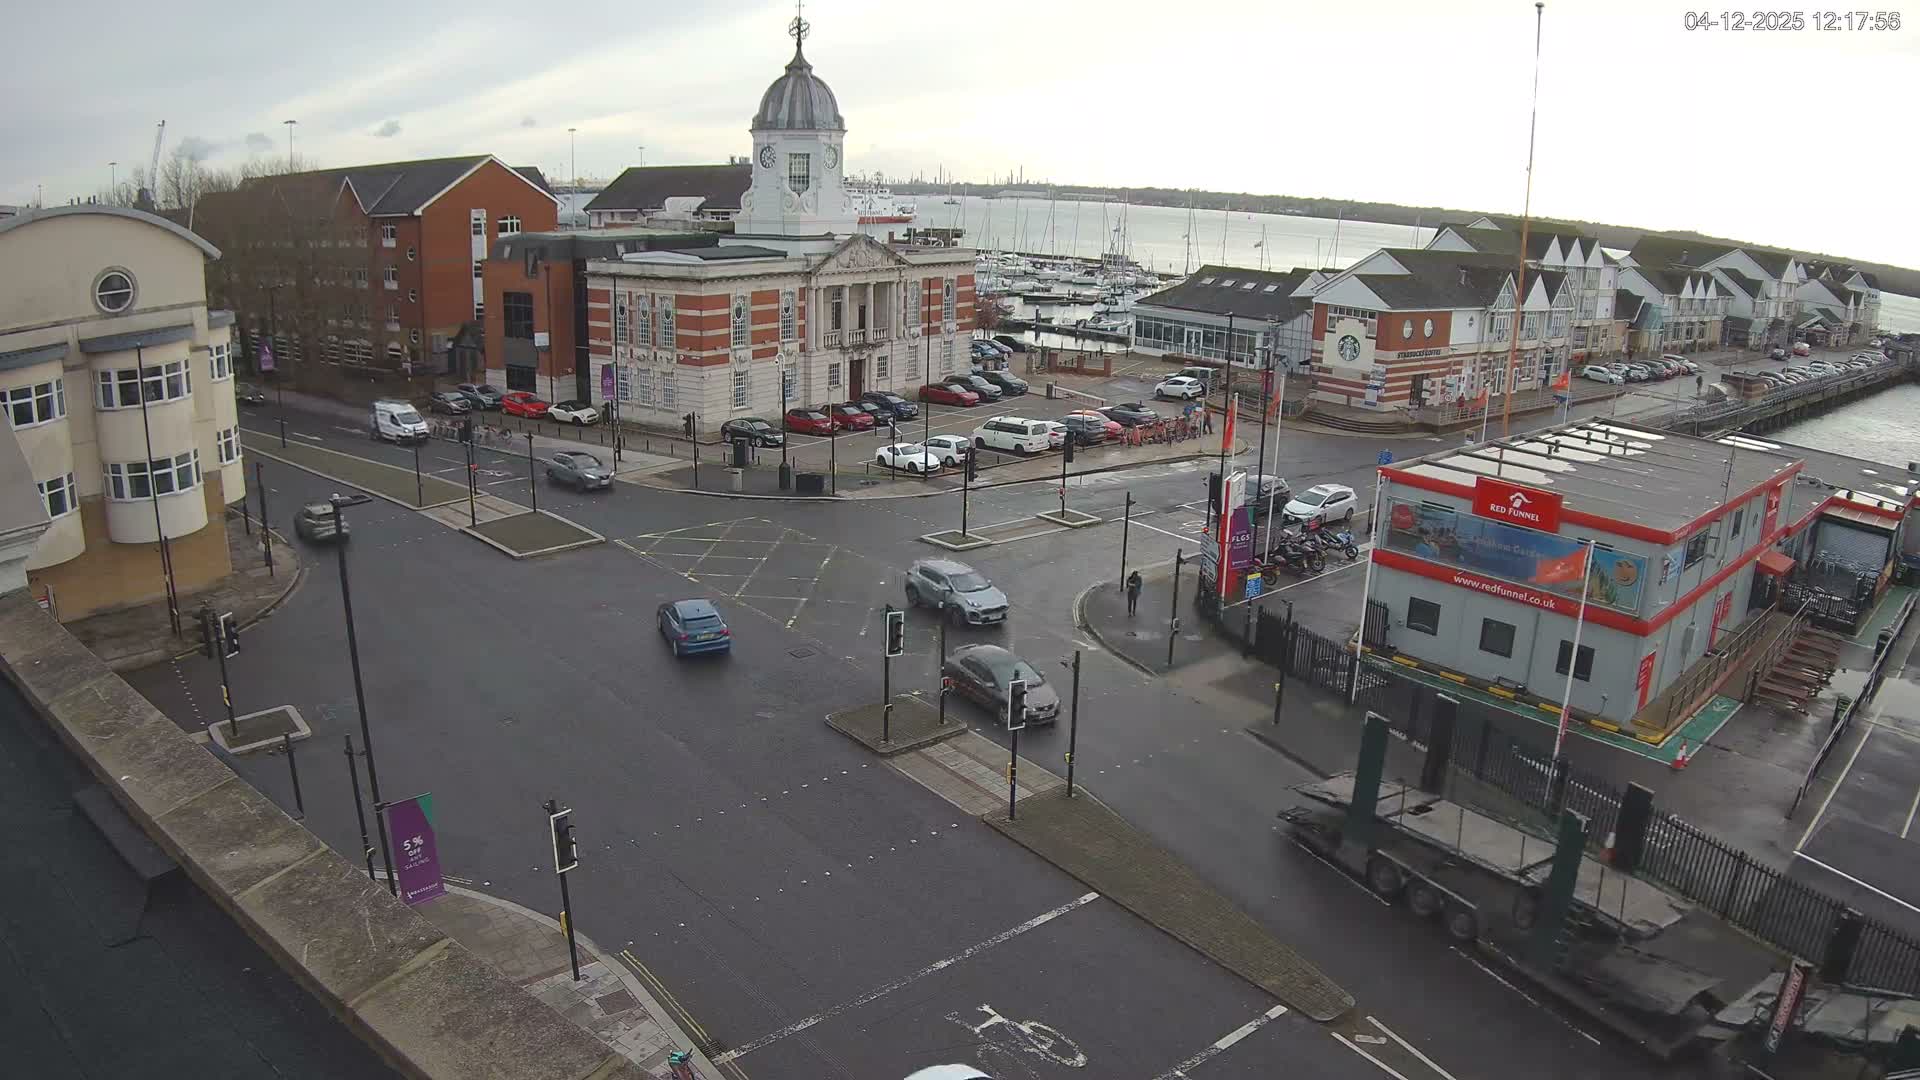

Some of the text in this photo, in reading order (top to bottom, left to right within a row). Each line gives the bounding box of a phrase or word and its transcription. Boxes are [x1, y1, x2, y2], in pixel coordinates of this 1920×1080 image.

[1490, 503, 1540, 522] RED FUNNEL
[1453, 575, 1556, 609] www.redfunnel.co.uk
[408, 847, 421, 857] OFF
[409, 854, 422, 862] ANY
[405, 856, 431, 871] SAILING
